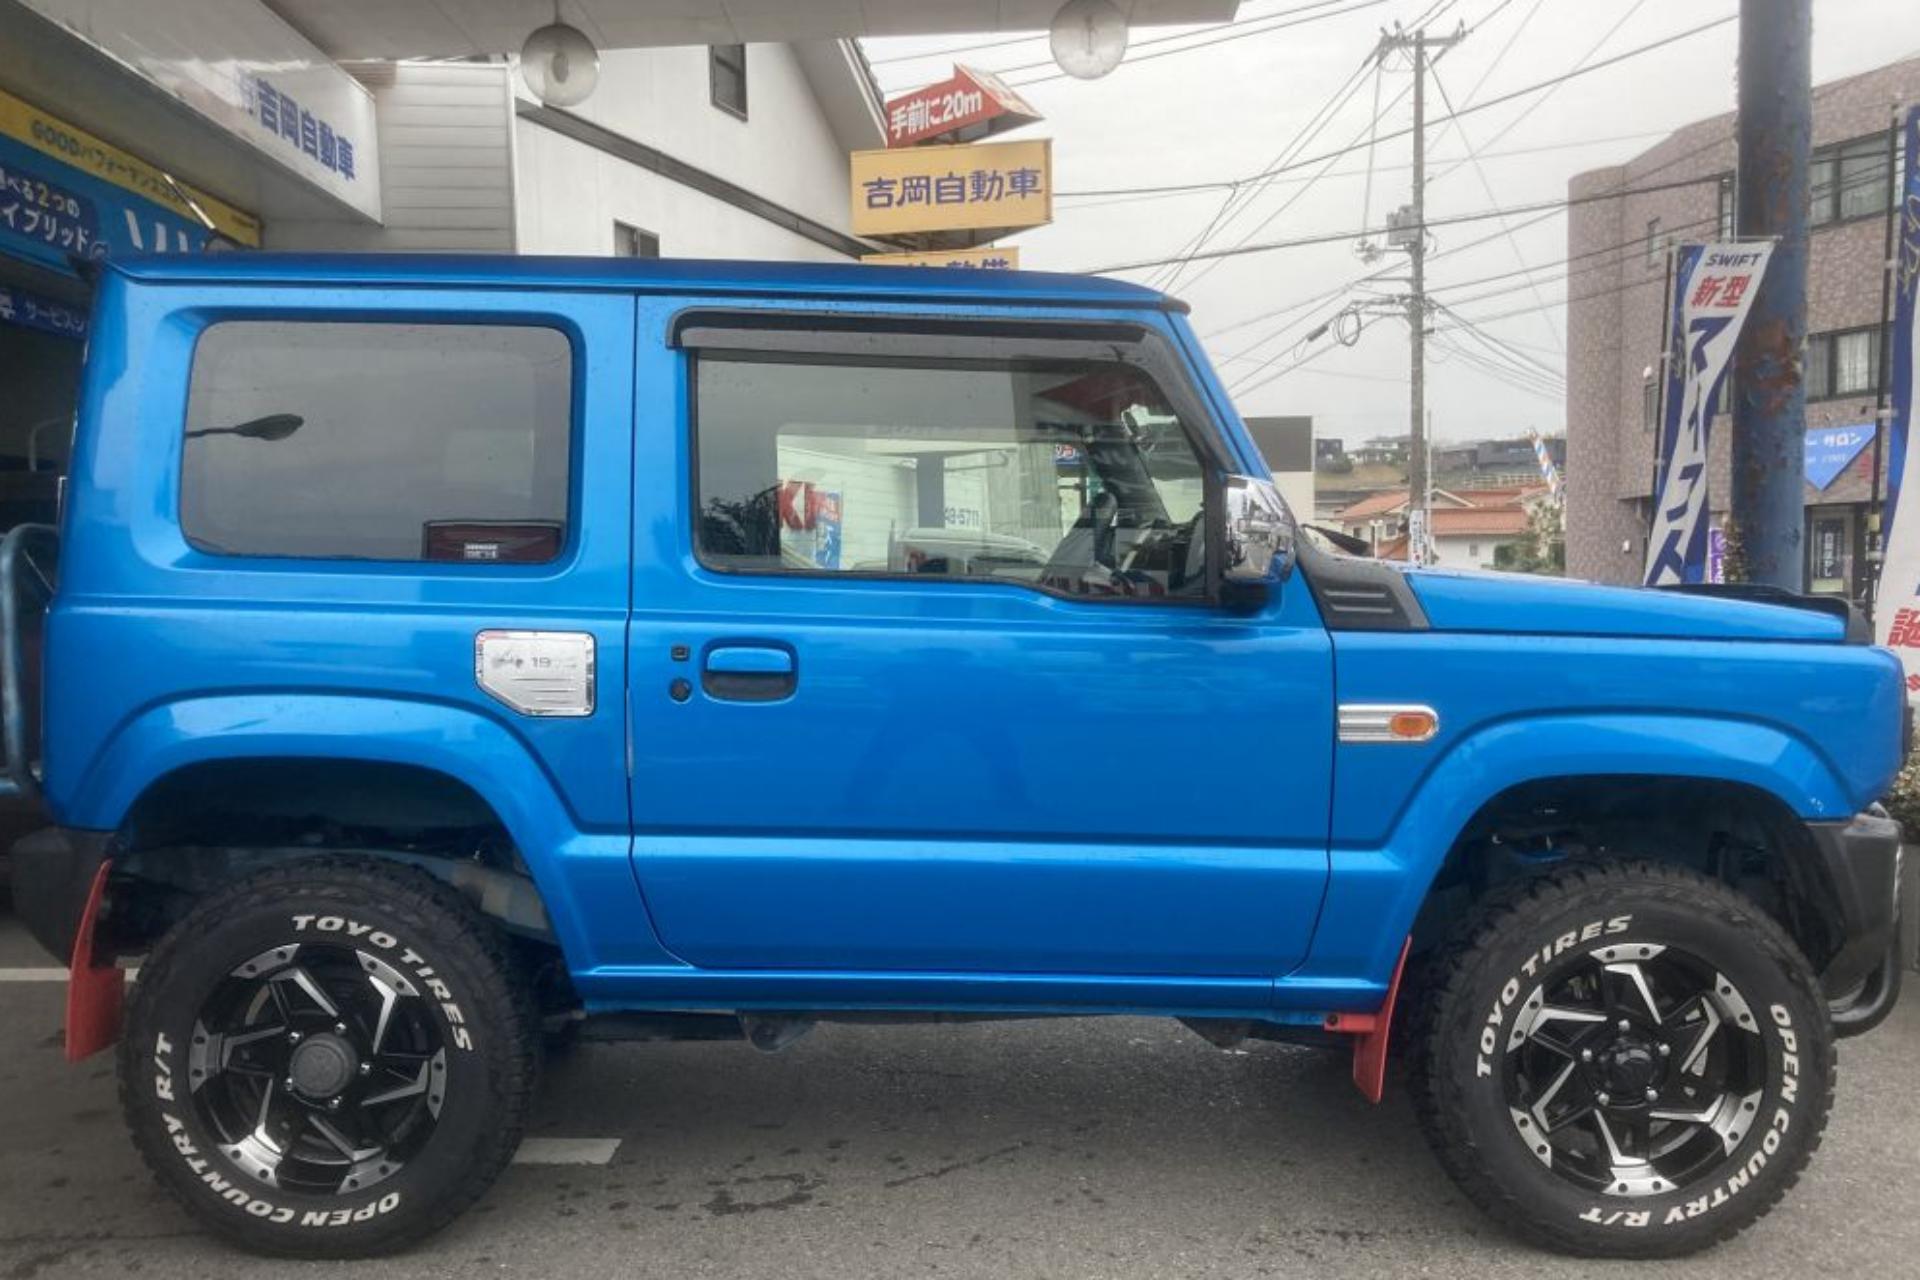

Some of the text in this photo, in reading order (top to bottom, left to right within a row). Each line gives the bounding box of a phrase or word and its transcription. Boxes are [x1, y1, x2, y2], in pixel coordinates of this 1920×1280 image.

[862, 166, 1042, 209] 吉岡自動車
[1704, 252, 1762, 267] SWIFT
[1691, 274, 1752, 308] 新型
[1645, 315, 1736, 587] スイフト
[291, 914, 474, 1052] TOYO TIRES
[1476, 913, 1634, 1079] TOYO TIRES
[154, 1032, 402, 1227] OPEN COUNTRY R/T
[1579, 1004, 1800, 1227] OPEN COUNTRY R/T
